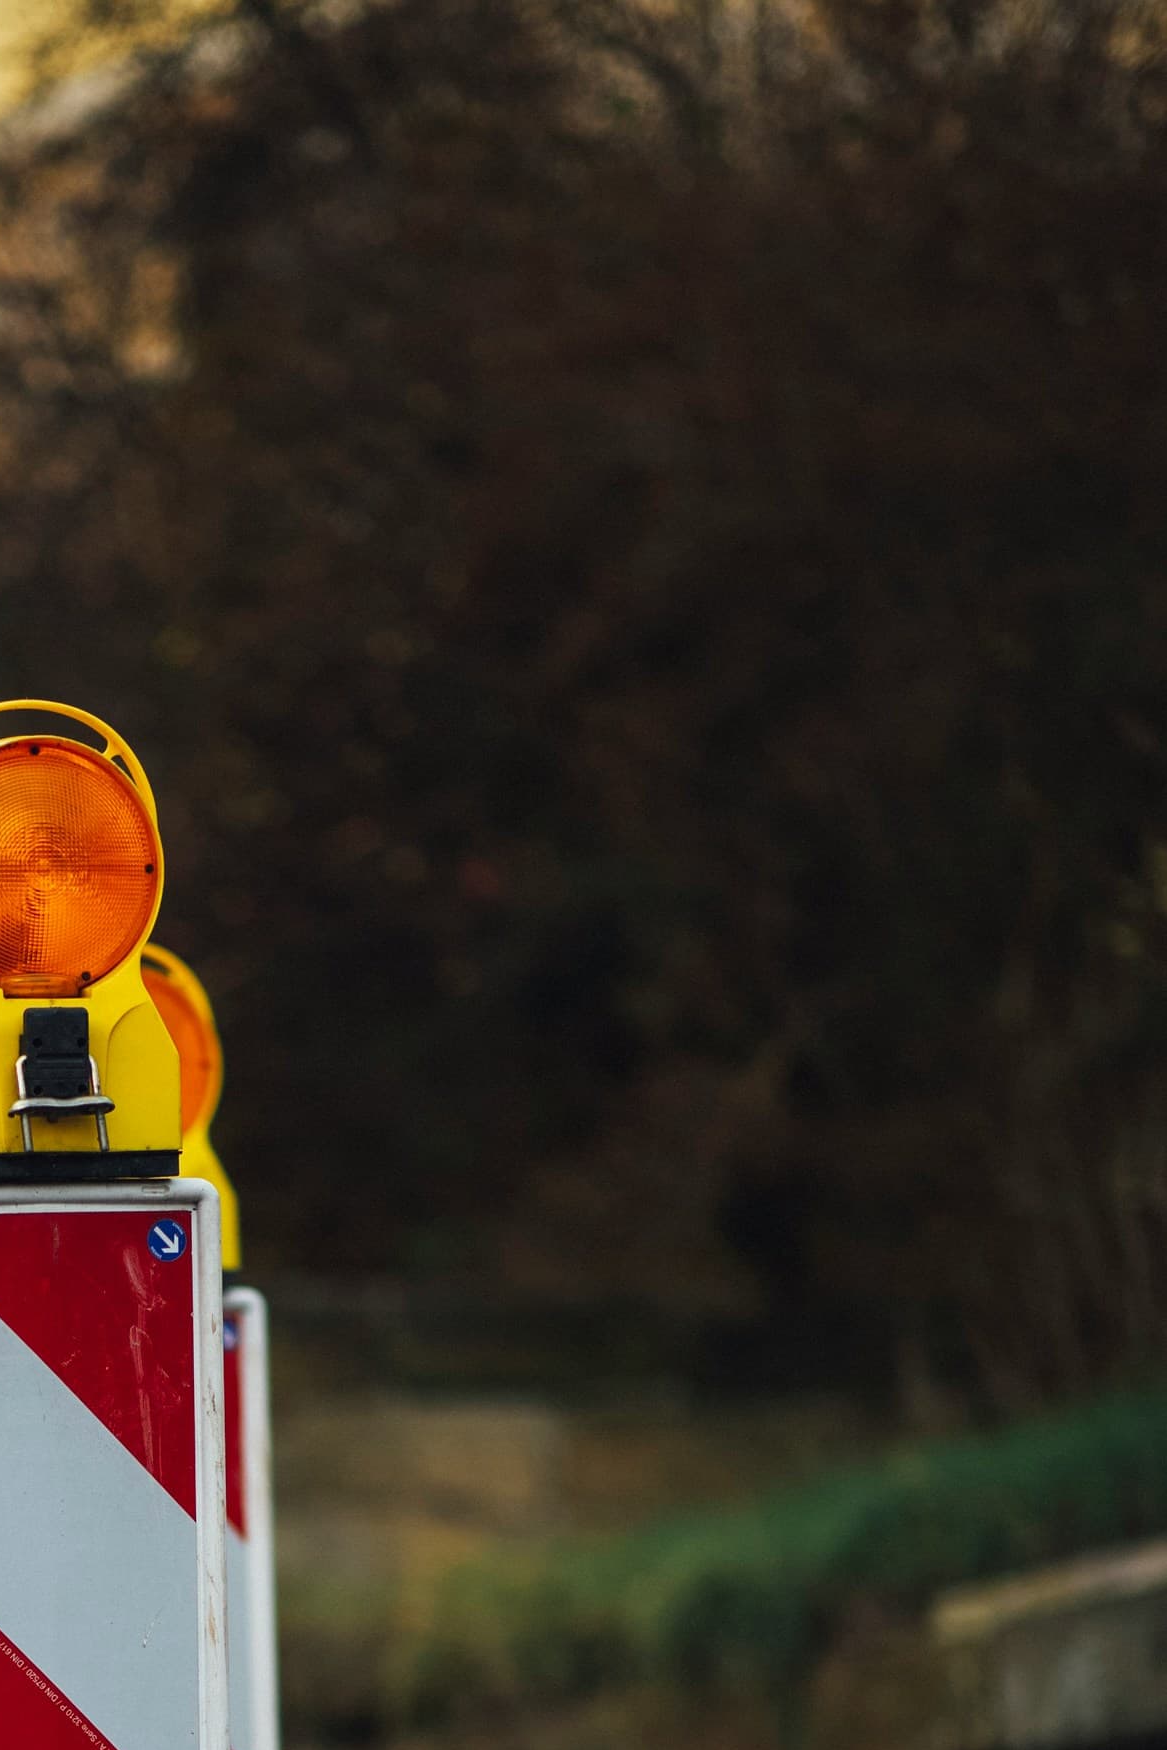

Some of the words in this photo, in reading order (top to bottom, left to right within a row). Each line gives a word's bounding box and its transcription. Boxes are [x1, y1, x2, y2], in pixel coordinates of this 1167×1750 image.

[9, 1652, 25, 1668] DIN
[25, 1668, 47, 1690] 67520
[44, 1687, 59, 1703] DIN
[65, 1708, 83, 1727] 3210
